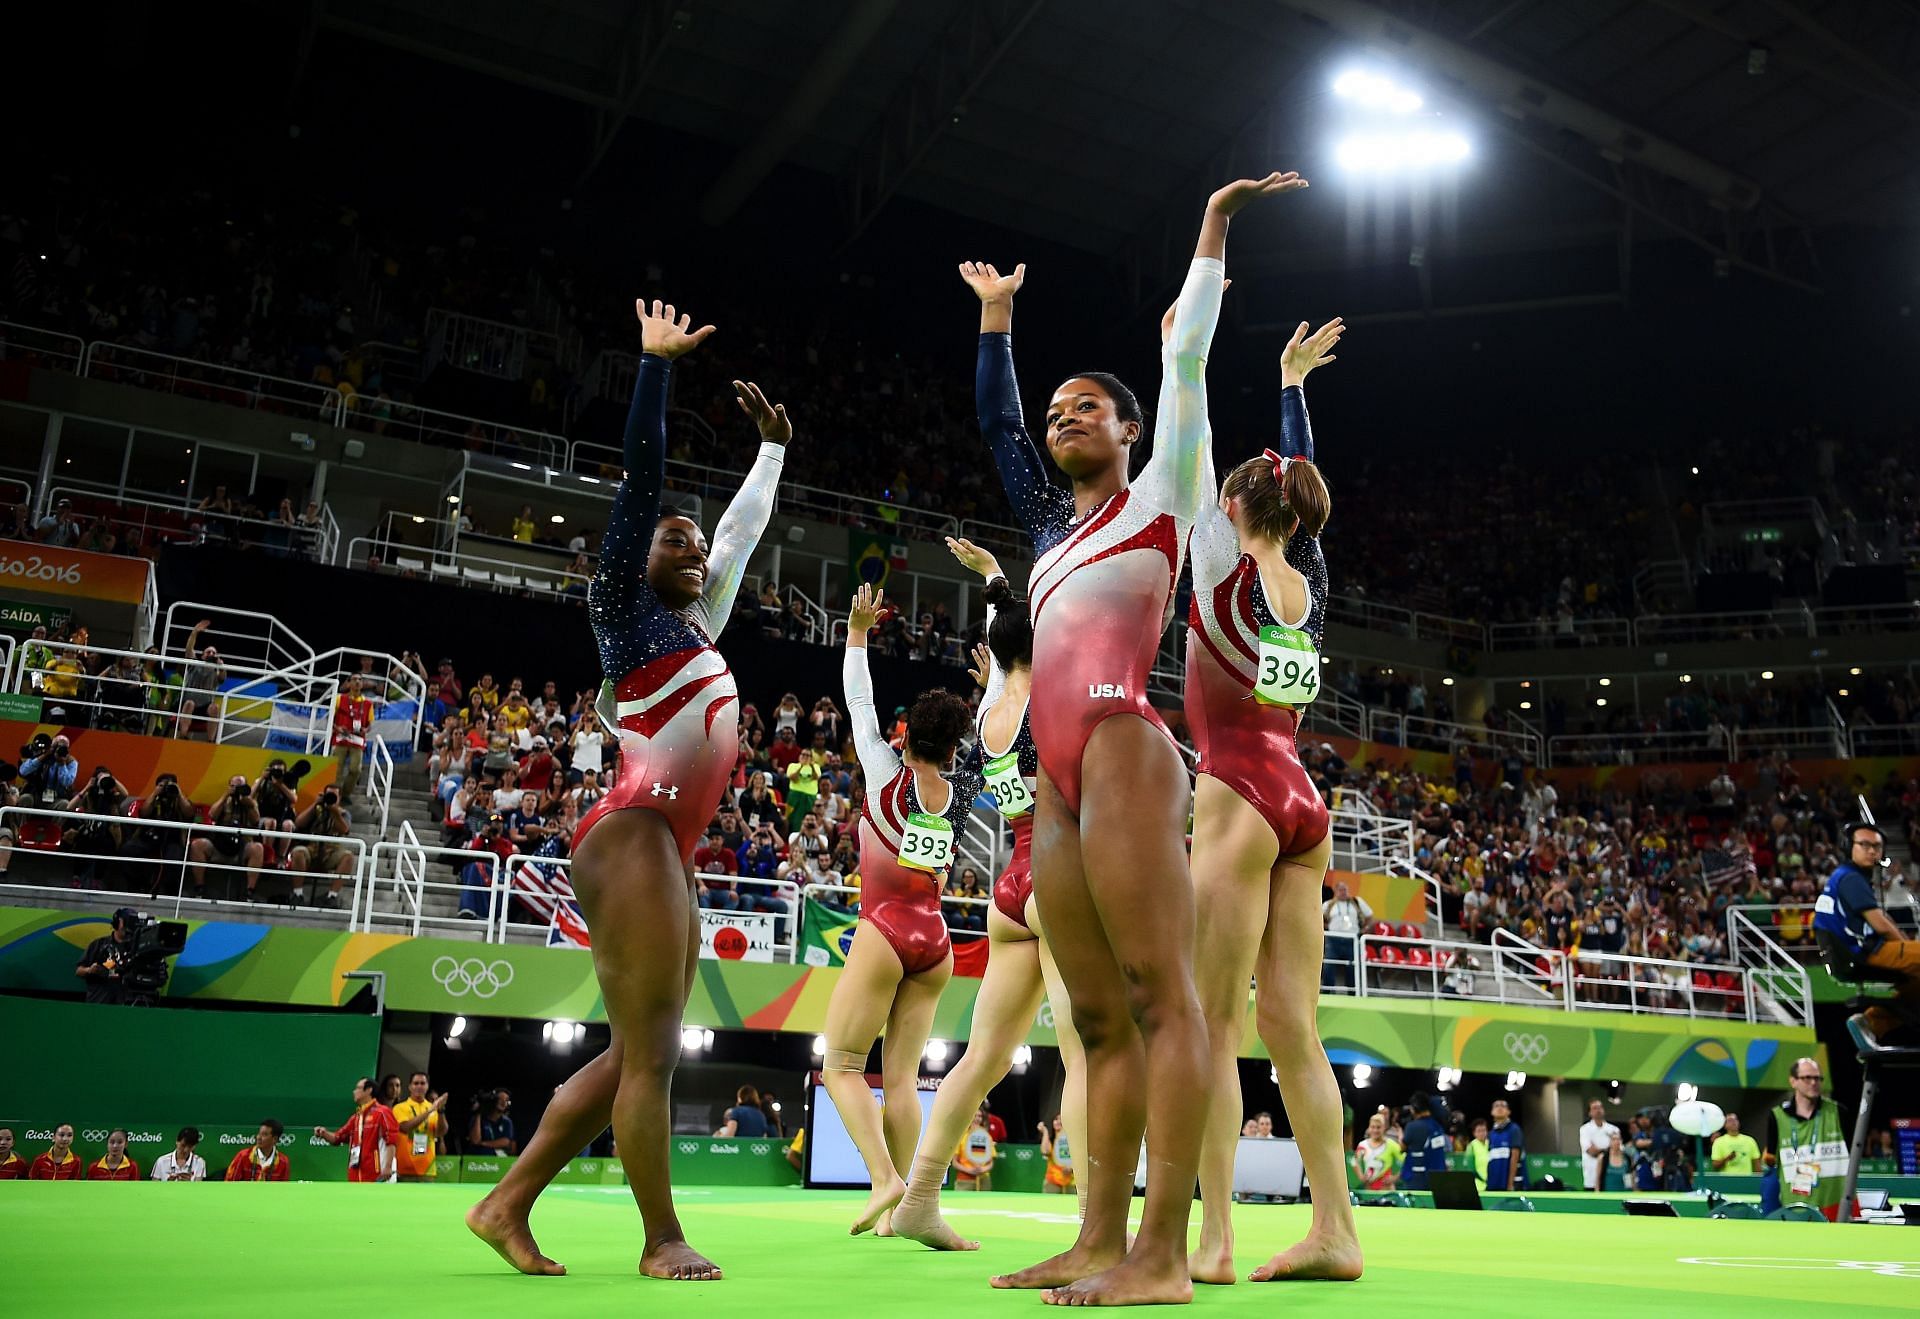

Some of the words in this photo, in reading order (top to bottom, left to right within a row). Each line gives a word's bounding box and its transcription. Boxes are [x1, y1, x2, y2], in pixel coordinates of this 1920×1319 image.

[0, 556, 80, 584] io2016
[0, 608, 42, 624] SAÍDA
[1270, 630, 1298, 643] Rio2016
[1261, 655, 1317, 696] 394
[1089, 684, 1126, 699] USA
[990, 777, 1026, 807] 395
[903, 832, 948, 860] 393
[917, 1077, 943, 1090] OMEG
[25, 1129, 55, 1141] Rio20
[127, 1131, 163, 1143] Rio2016
[219, 1133, 256, 1145] Rio2016
